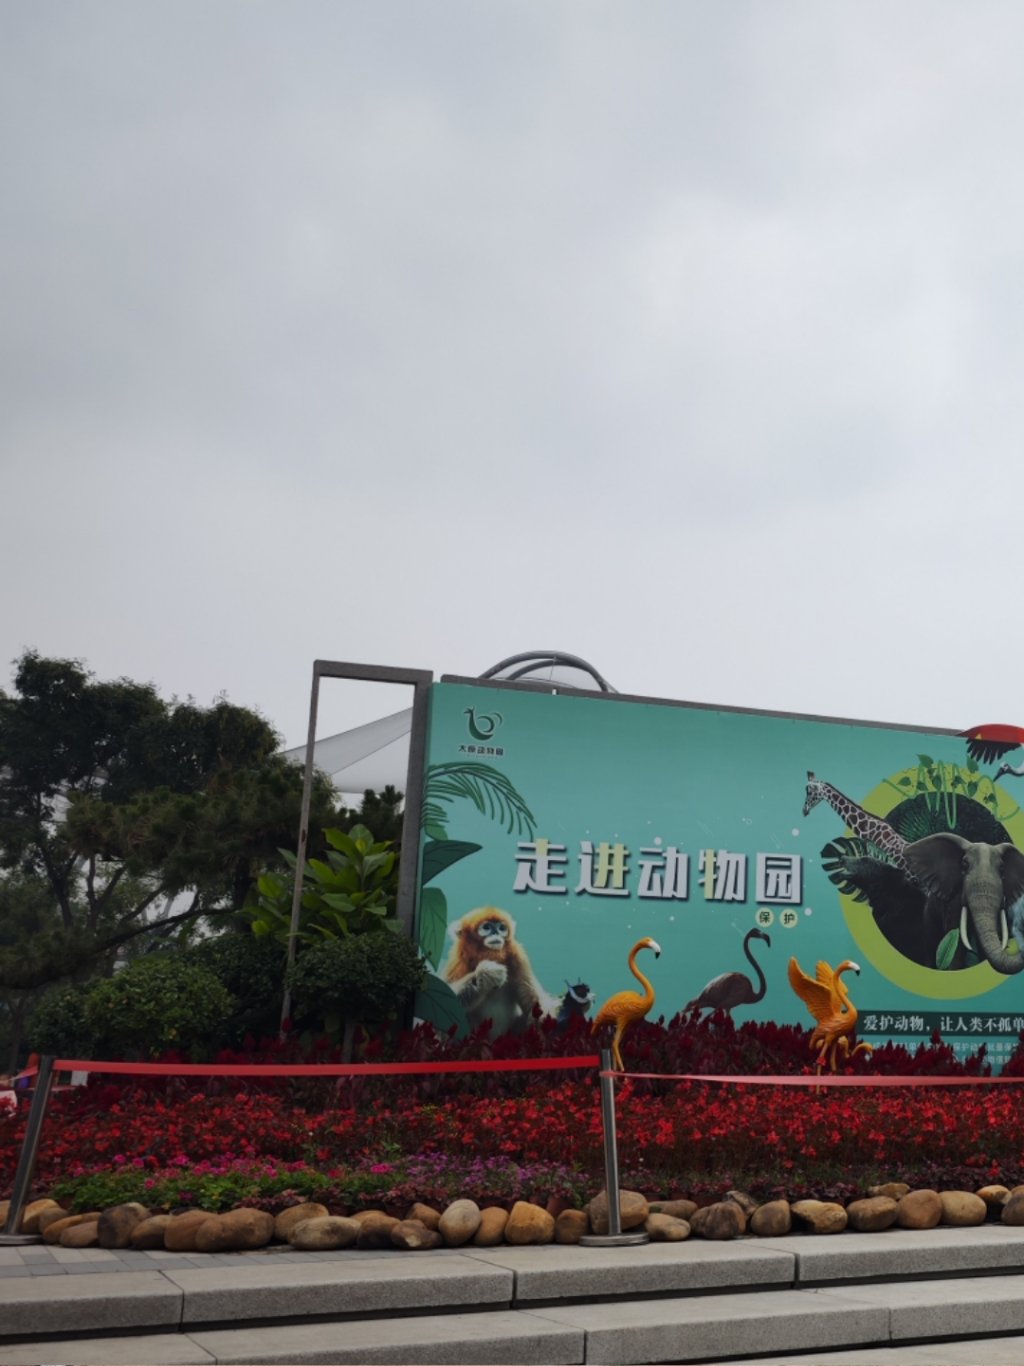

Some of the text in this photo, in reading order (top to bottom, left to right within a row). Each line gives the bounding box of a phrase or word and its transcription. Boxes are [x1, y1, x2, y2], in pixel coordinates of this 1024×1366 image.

[512, 838, 802, 904] 走进动物园
[758, 910, 796, 926] 保护
